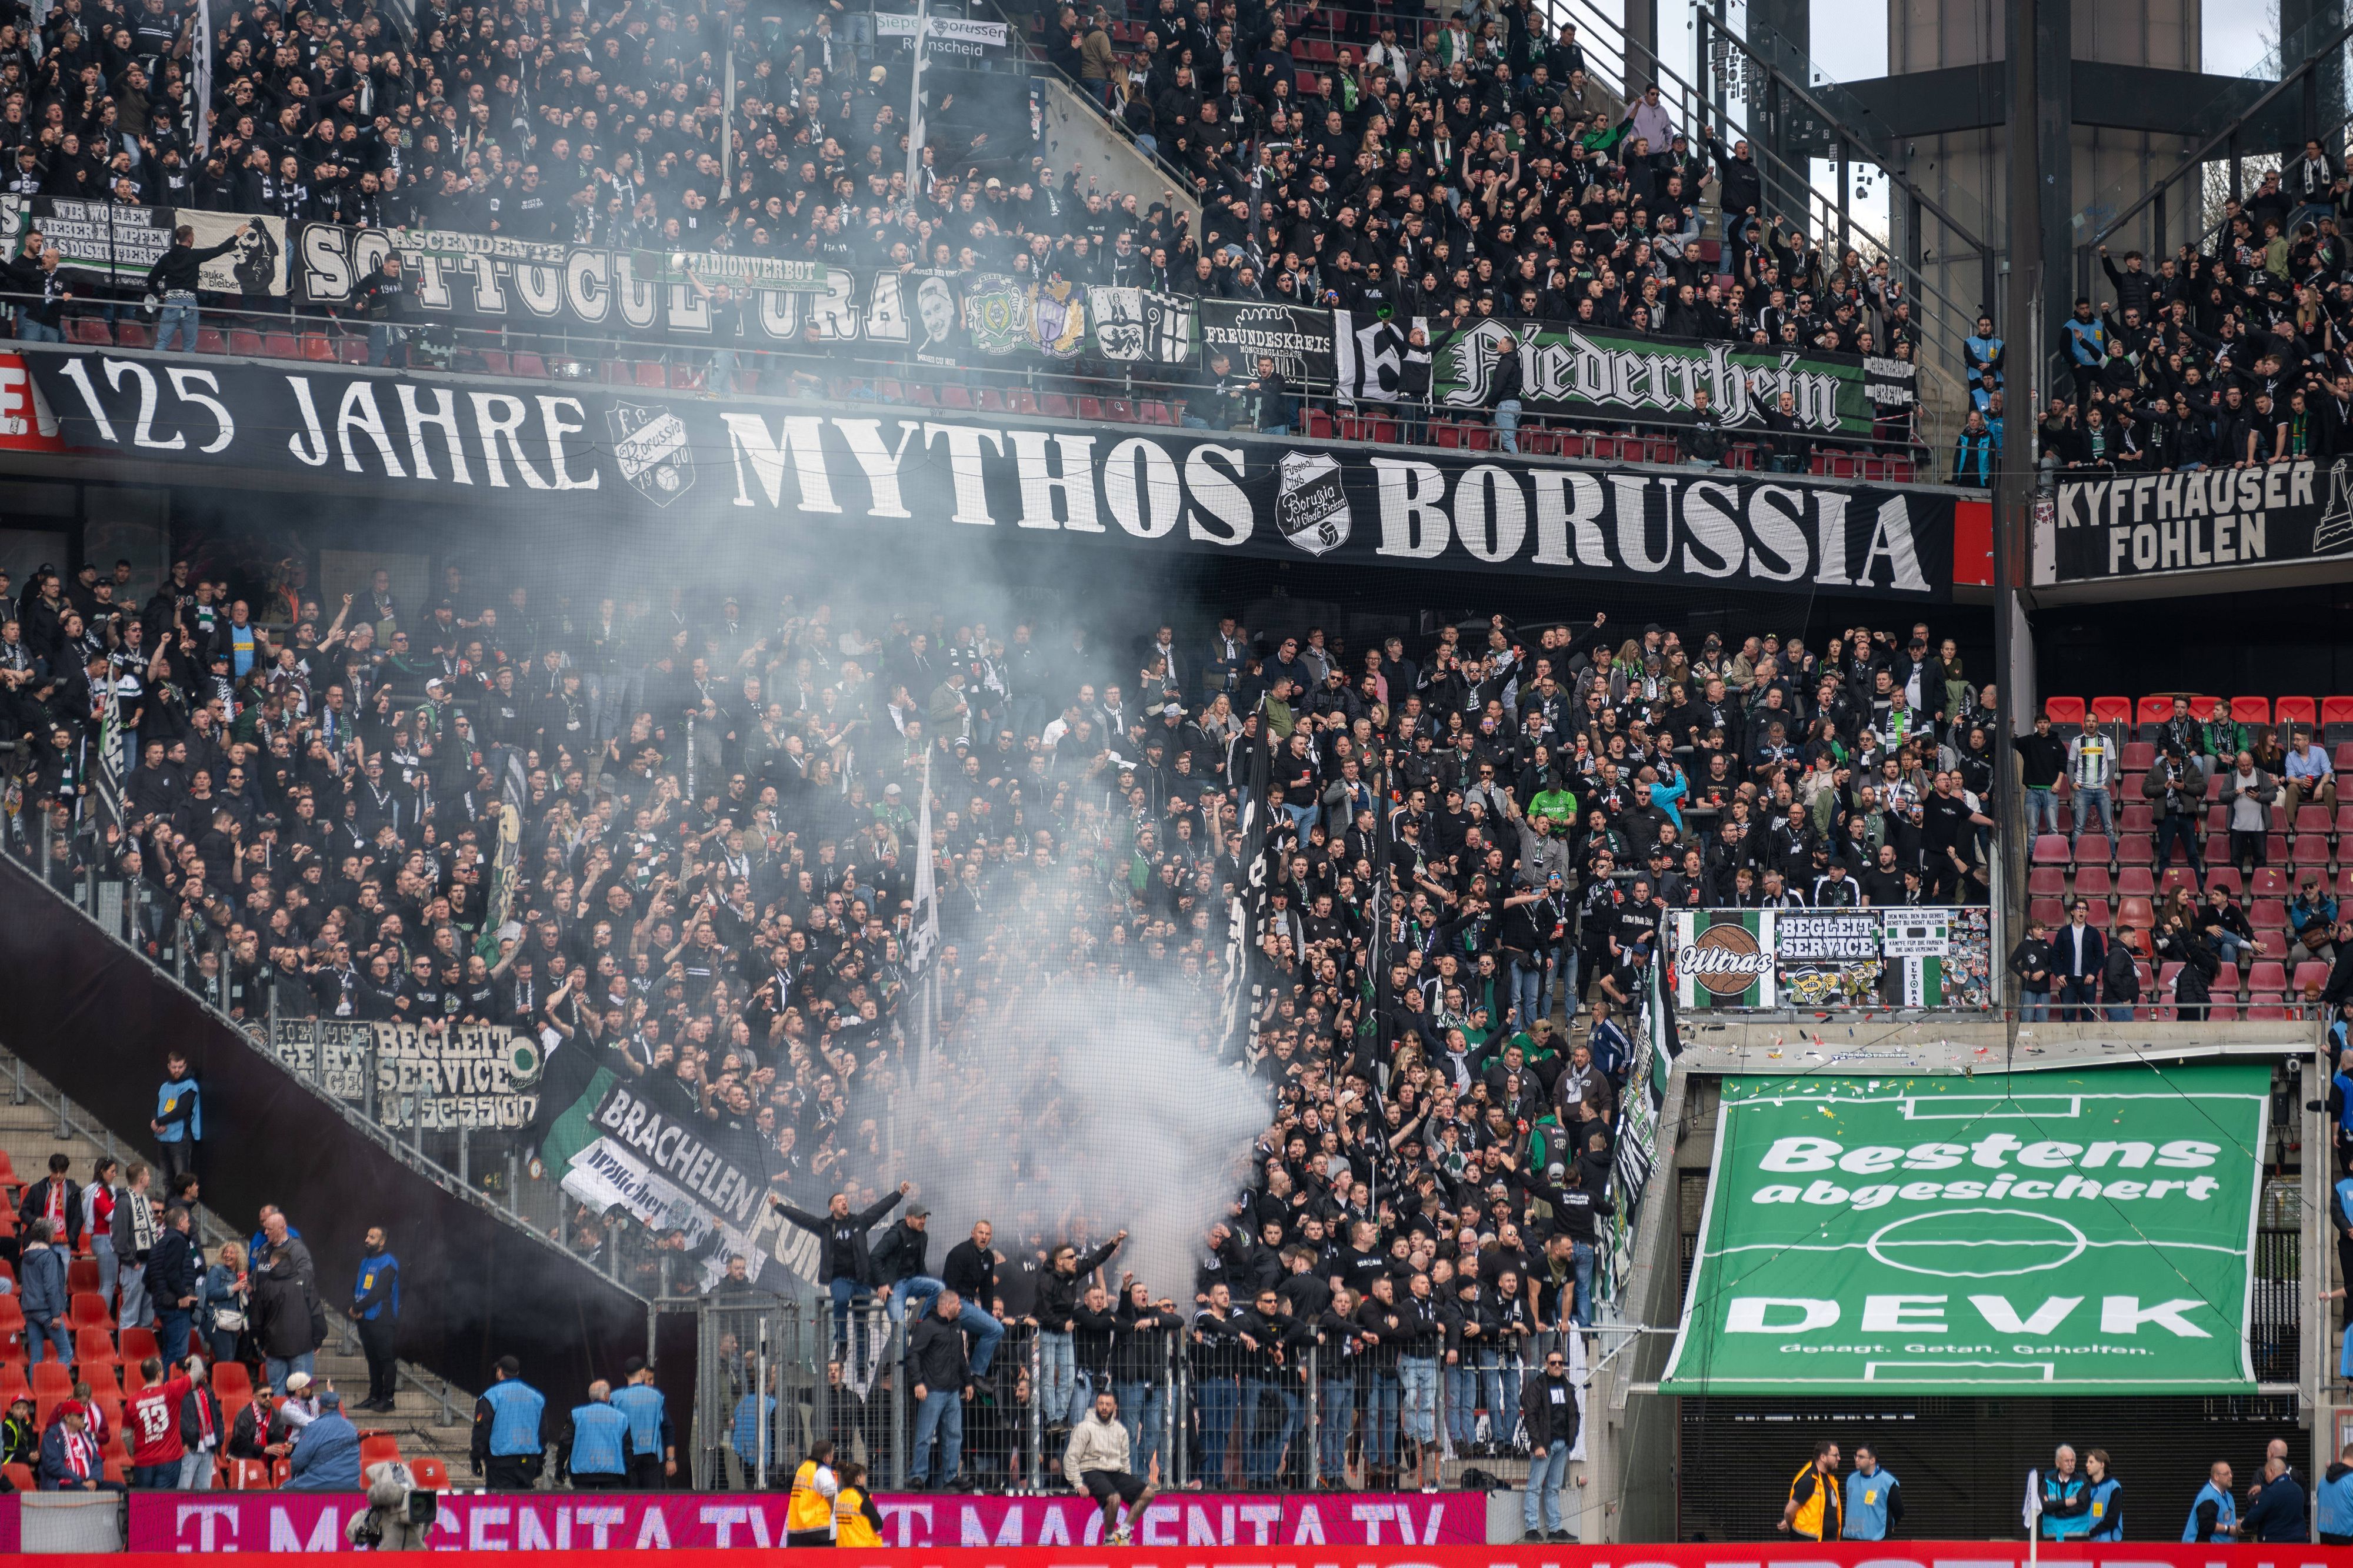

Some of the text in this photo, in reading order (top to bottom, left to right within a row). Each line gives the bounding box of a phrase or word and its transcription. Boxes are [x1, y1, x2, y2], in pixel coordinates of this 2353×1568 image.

[877, 16, 919, 28] Siepe
[32, 216, 95, 242] LIEBER
[52, 200, 152, 227] WIR WOLLEN
[389, 230, 565, 265] ASCENDENTE
[1204, 326, 1331, 353] FREUNDESKREIS
[1870, 356, 1909, 378] GRENZLAND
[1874, 383, 1904, 406] CREW
[58, 356, 600, 490] 125 JAHRE
[619, 419, 681, 475] Borussia
[719, 412, 1254, 546] MYTHOS
[1284, 458, 1314, 478] Fussball
[1285, 473, 1305, 492] Club
[1282, 485, 1335, 522] Borussia
[2057, 460, 2315, 529] KYFFHÄUSER
[1370, 456, 1932, 592] BORUSSIA
[2108, 512, 2267, 574] FOHLEN
[1781, 918, 1875, 938] BEGLEIT
[1681, 945, 1772, 975] Ultras
[1781, 938, 1875, 958] SERVICE
[375, 1022, 511, 1060] BEGLEIT
[376, 1057, 510, 1094] SERVICE
[601, 1088, 759, 1222] BRACHELEN
[1758, 1132, 2222, 1175] Bestens
[1751, 1173, 2220, 1210] abgesichert
[1724, 1294, 2215, 1337] DEVK
[1778, 1342, 2155, 1355] Gesagt. Getan. Geholfen.
[139, 1403, 171, 1436] 13
[270, 1505, 672, 1552] MENTA
[1351, 1503, 1445, 1546] TV
